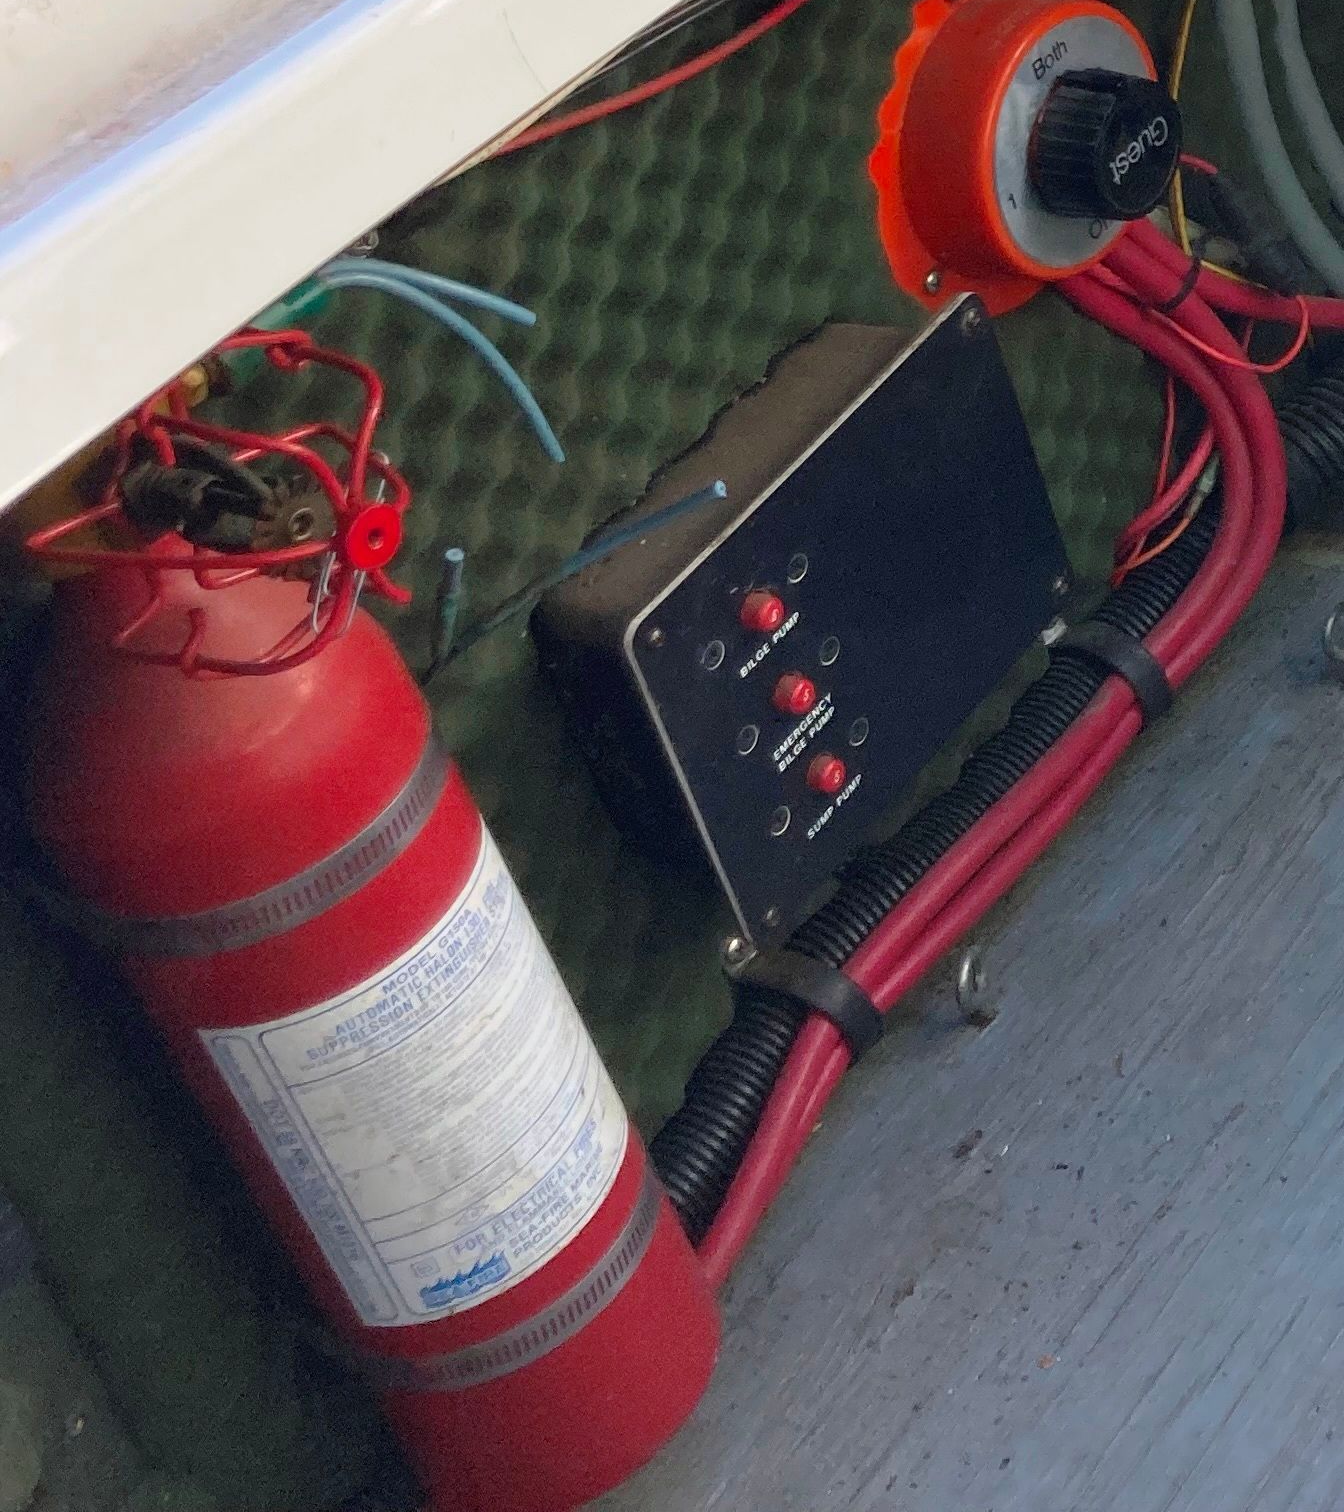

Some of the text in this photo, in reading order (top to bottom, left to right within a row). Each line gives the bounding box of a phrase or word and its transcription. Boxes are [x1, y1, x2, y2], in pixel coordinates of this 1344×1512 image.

[1032, 40, 1068, 81] Both
[1109, 116, 1168, 185] Guest
[740, 611, 799, 678] BILGE PUMP
[773, 692, 832, 762] EMERGENCY
[778, 705, 835, 774] BILGE PUMP
[807, 773, 862, 839] SUMP PUMP
[306, 914, 491, 1060] SUPPRESSION EXTINGUISHER
[334, 978, 424, 1037] AUTOMATIC
[424, 939, 463, 979] HALON
[382, 951, 437, 995] MODEL
[492, 1161, 573, 1235] ELECTRICAL
